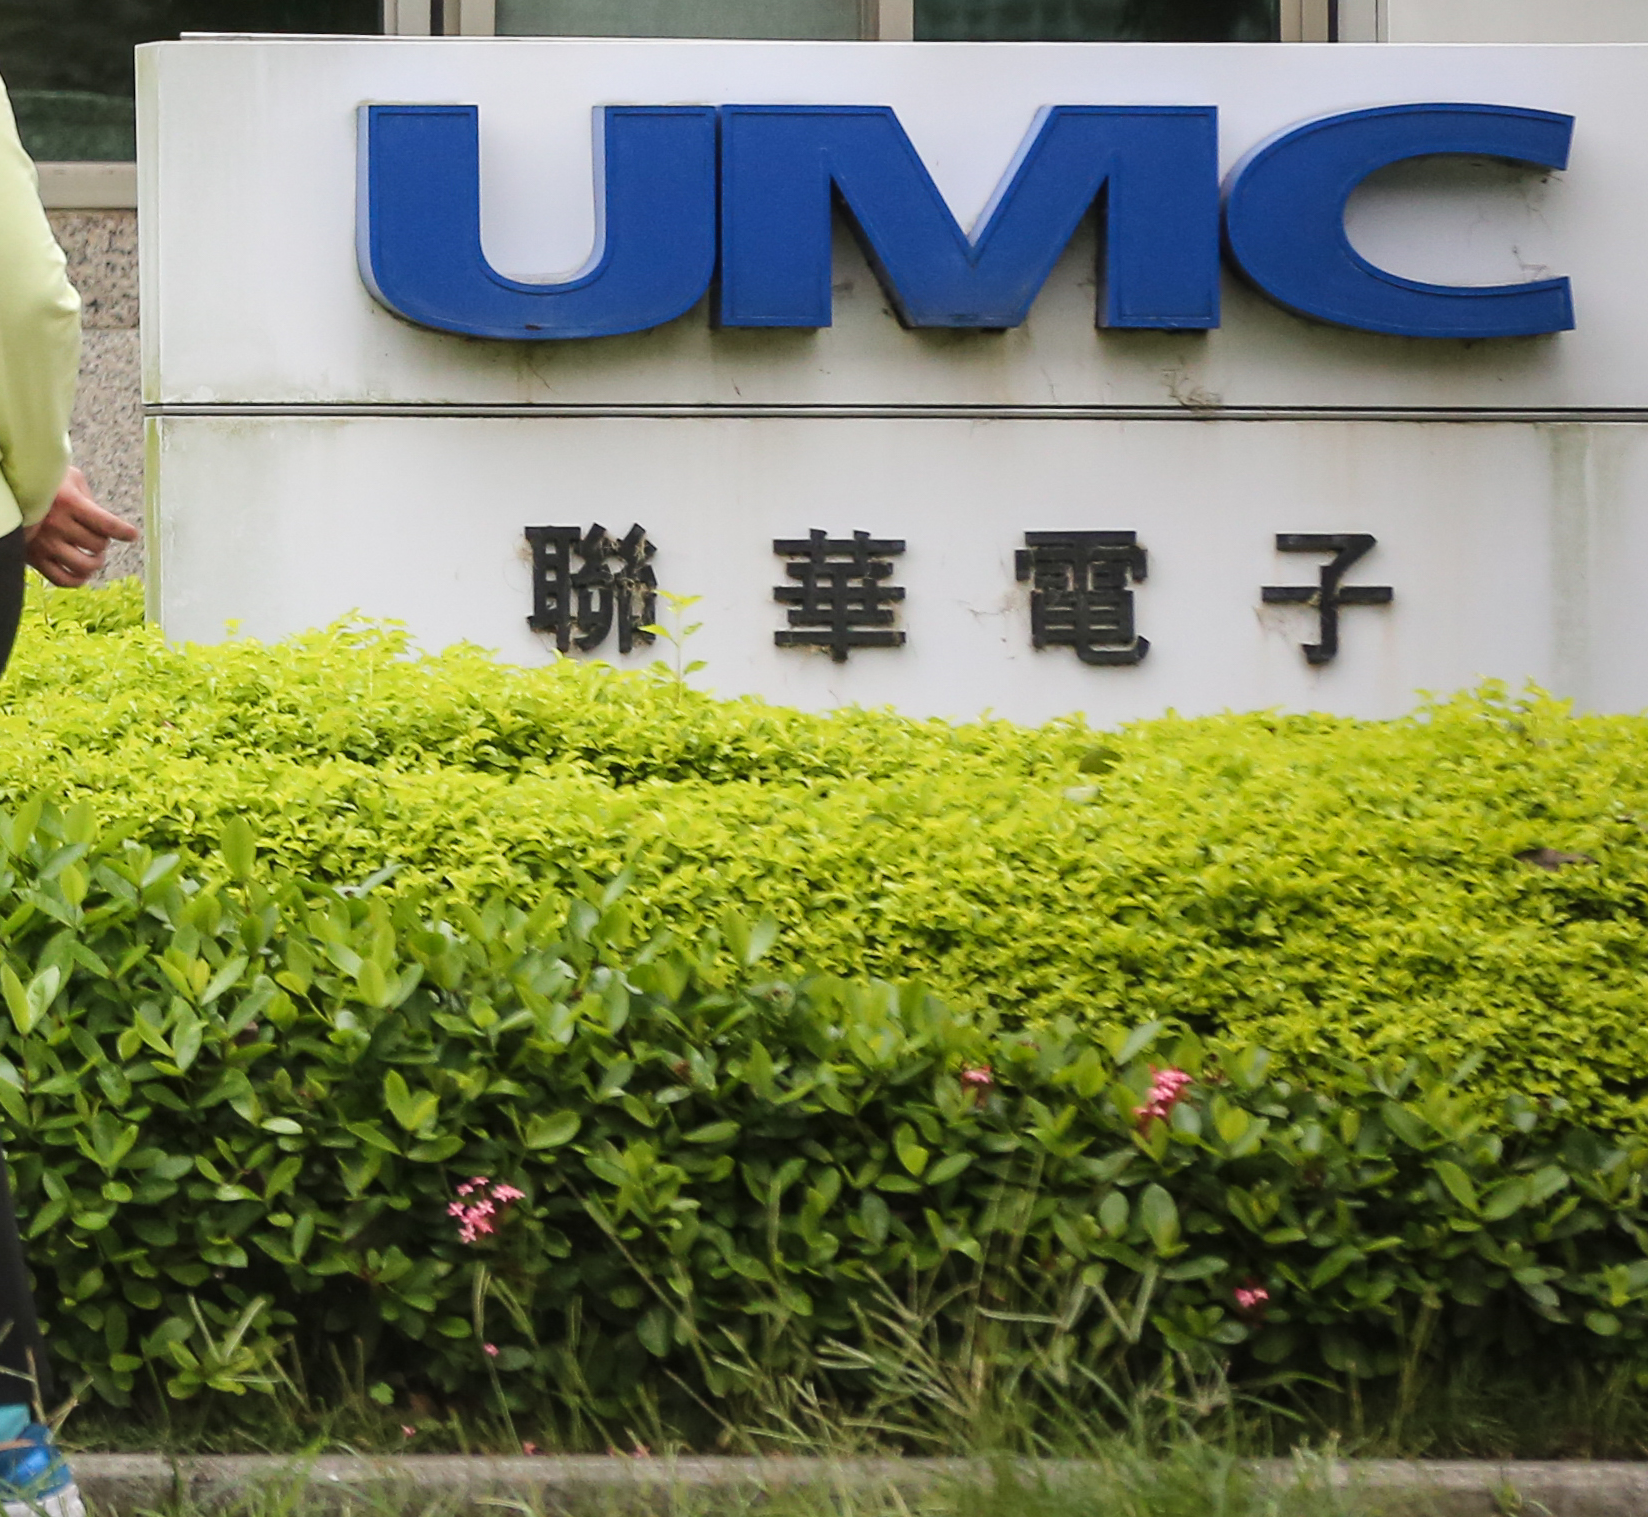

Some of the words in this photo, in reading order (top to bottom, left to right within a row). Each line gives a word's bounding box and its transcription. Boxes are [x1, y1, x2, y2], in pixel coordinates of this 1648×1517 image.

[356, 102, 1576, 340] UMC
[524, 522, 1394, 665] 聯華電子
